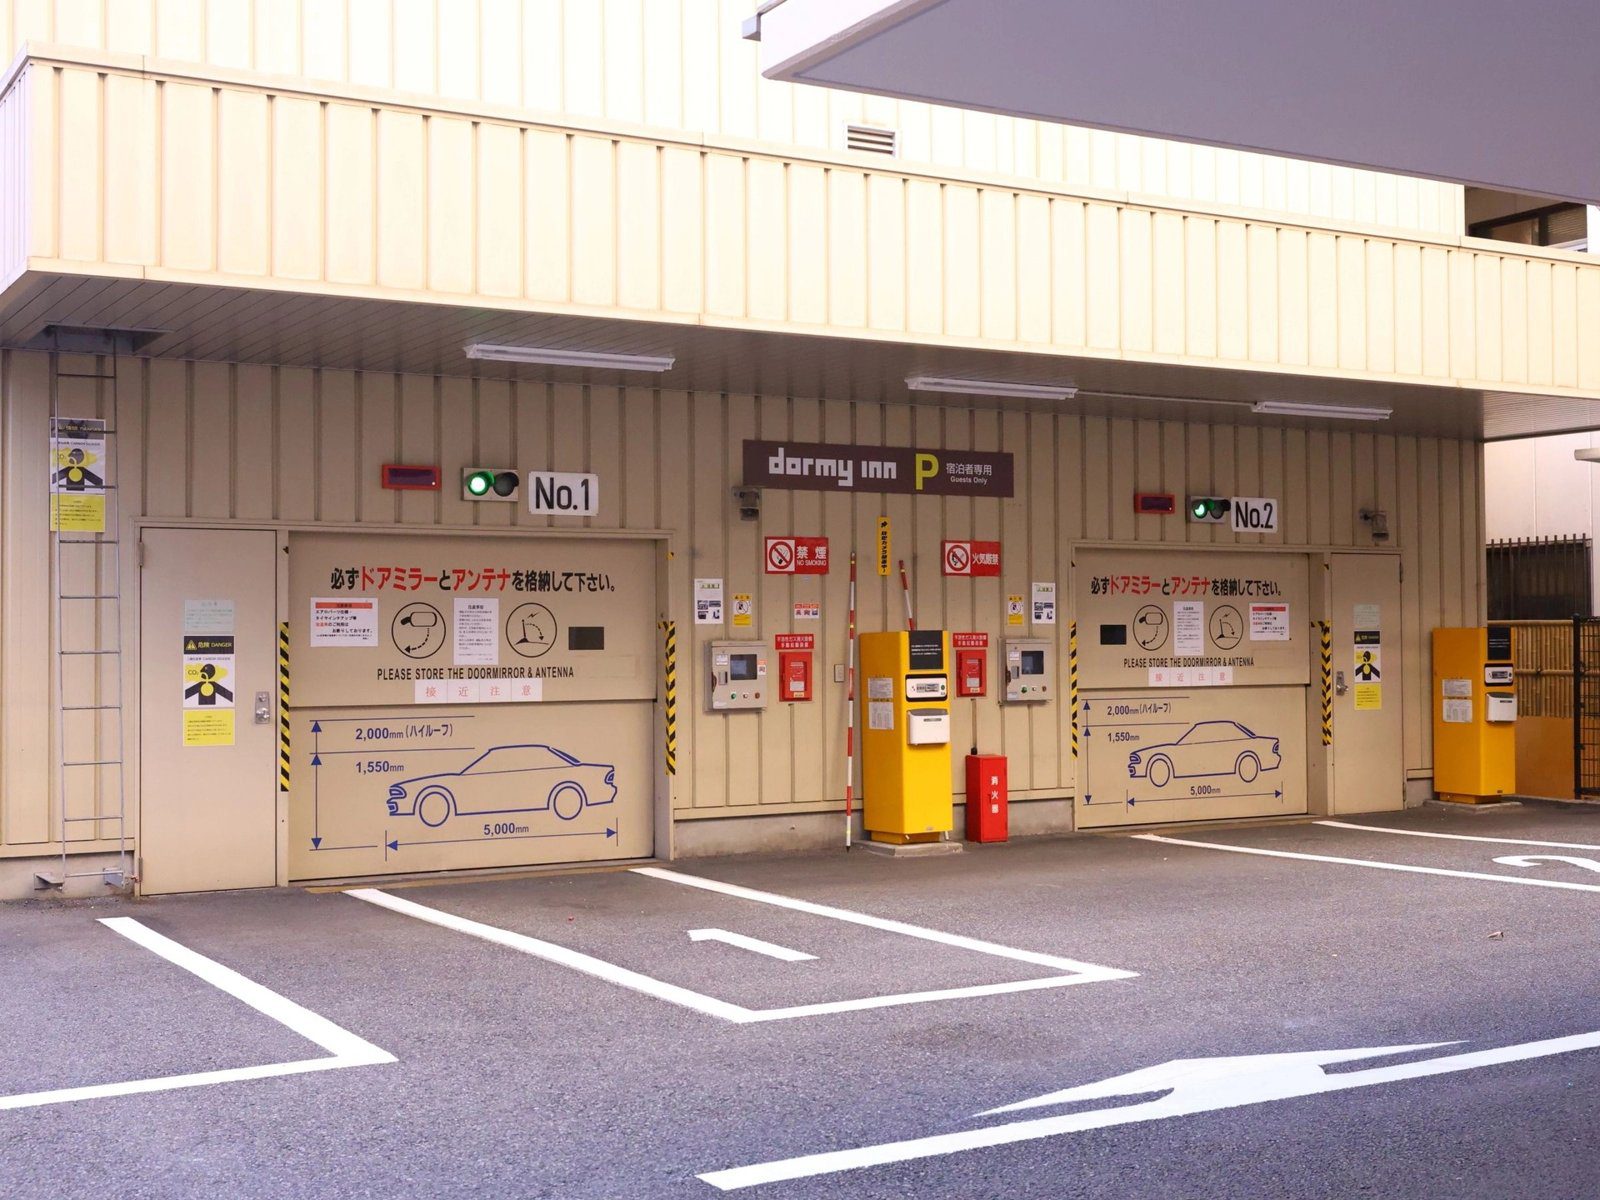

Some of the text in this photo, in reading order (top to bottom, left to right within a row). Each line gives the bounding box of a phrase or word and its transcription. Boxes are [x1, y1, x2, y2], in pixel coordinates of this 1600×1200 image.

[769, 447, 939, 490] dormy inn P
[946, 462, 992, 476] 宿泊者専用
[950, 475, 988, 486] Guests Only
[535, 476, 590, 511] No.1
[1235, 501, 1273, 529] No.2
[796, 546, 827, 559] 禁煙
[331, 566, 615, 592] 必ずドアミラーとアンテナを格納して下さい。
[1123, 657, 1254, 668] PLEASE STORE THE DOORMIRROR & ANTENNA
[377, 666, 575, 681] PLEASE STORE THE DOORMIRROR & ANTENNA
[426, 685, 532, 698] 接近注意
[1107, 705, 1139, 716] 2,000mm
[355, 723, 454, 742] 2,000mm (ハイルーフ)
[1107, 732, 1140, 742] 1,550mm
[355, 760, 404, 775] 1,550mm
[1190, 785, 1221, 796] 5,000mm
[483, 822, 530, 836] 5,000mm
[687, 928, 821, 962] 1
